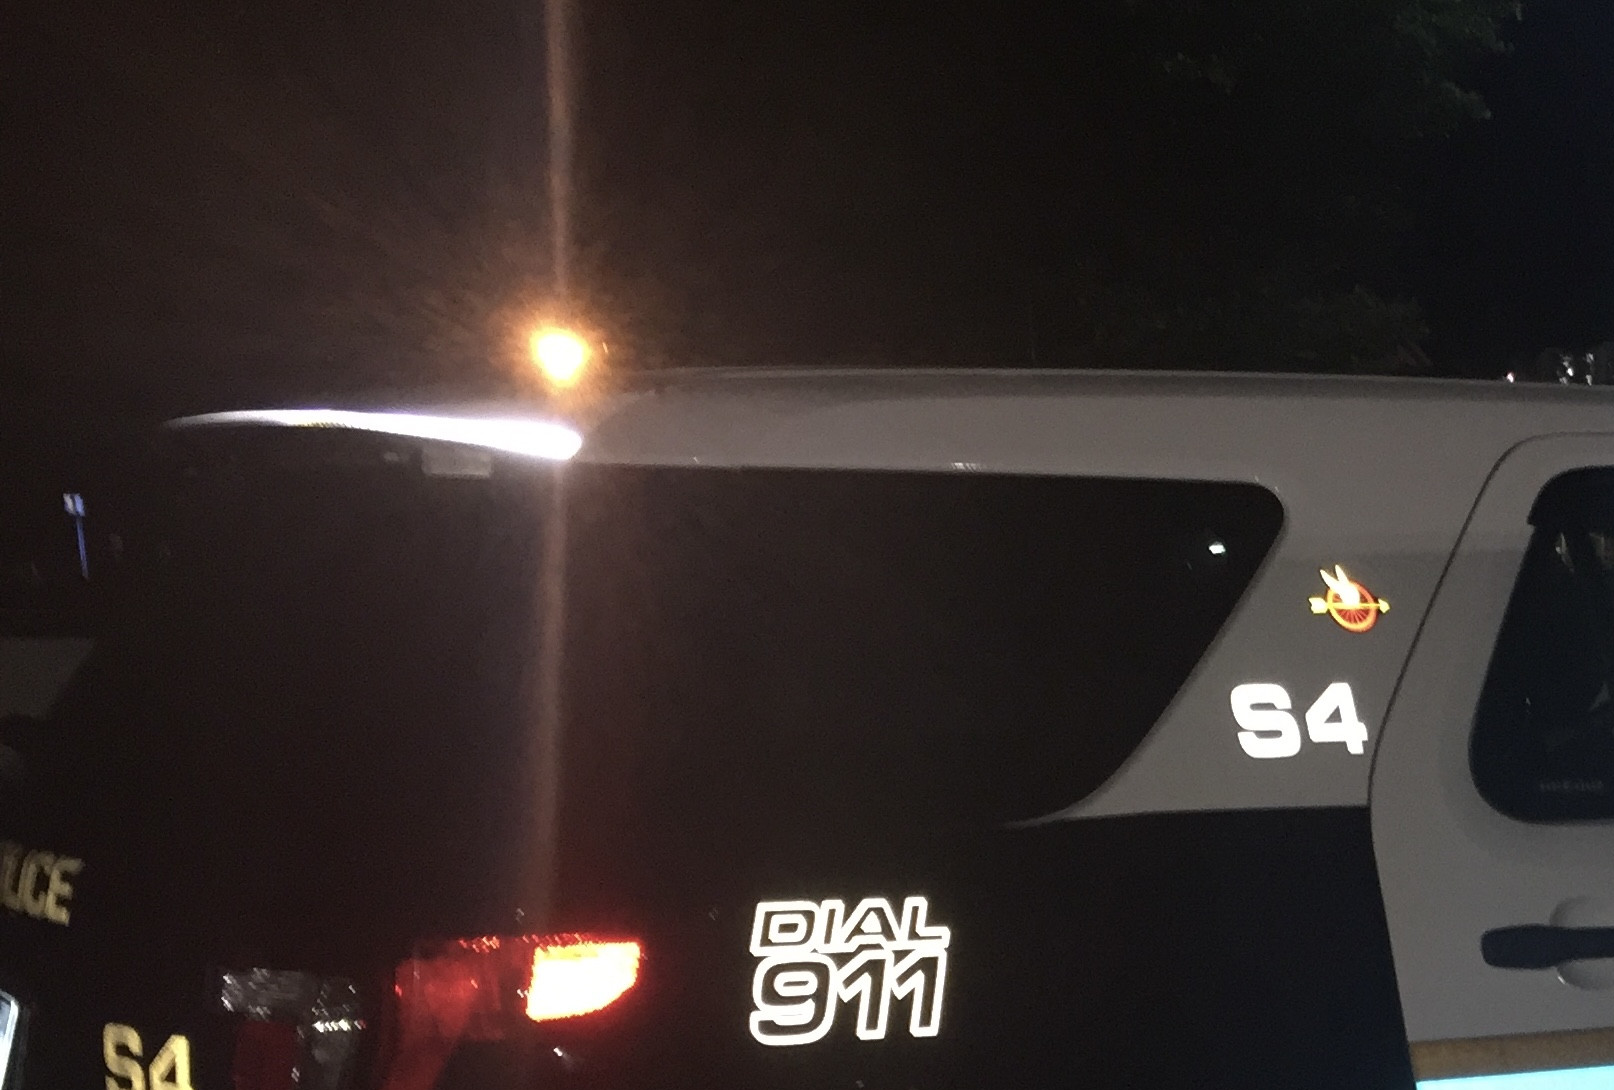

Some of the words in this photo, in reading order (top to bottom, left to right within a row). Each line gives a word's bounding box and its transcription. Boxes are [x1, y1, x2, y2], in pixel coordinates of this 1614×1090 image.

[1230, 681, 1369, 759] S4
[749, 896, 951, 957] DIAL
[749, 948, 949, 1046] 911
